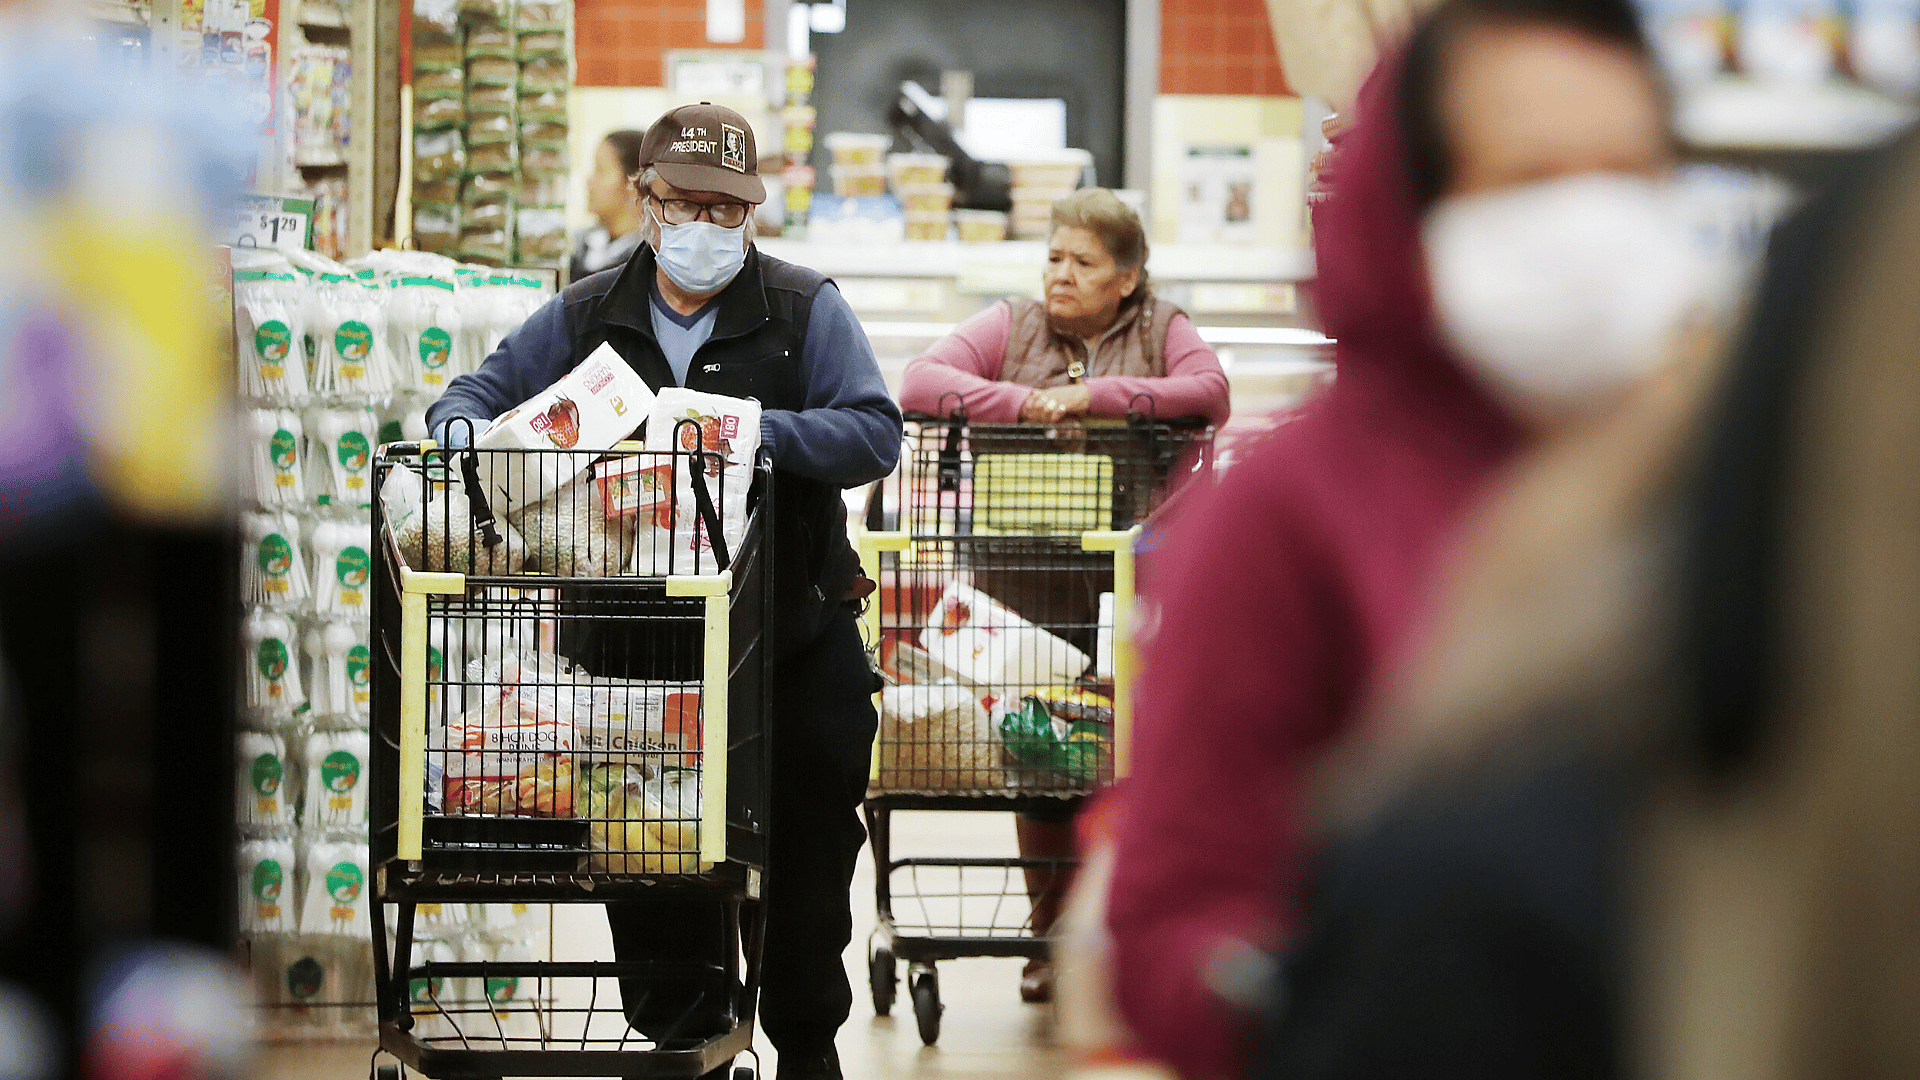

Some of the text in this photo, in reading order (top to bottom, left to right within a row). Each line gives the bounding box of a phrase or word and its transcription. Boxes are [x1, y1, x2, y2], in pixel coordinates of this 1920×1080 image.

[681, 127, 707, 139] 44 TH
[670, 142, 718, 153] PRESIDENT
[532, 414, 548, 432] 180
[724, 417, 737, 436] 180
[491, 733, 498, 743] 8
[613, 735, 676, 749] Chicken
